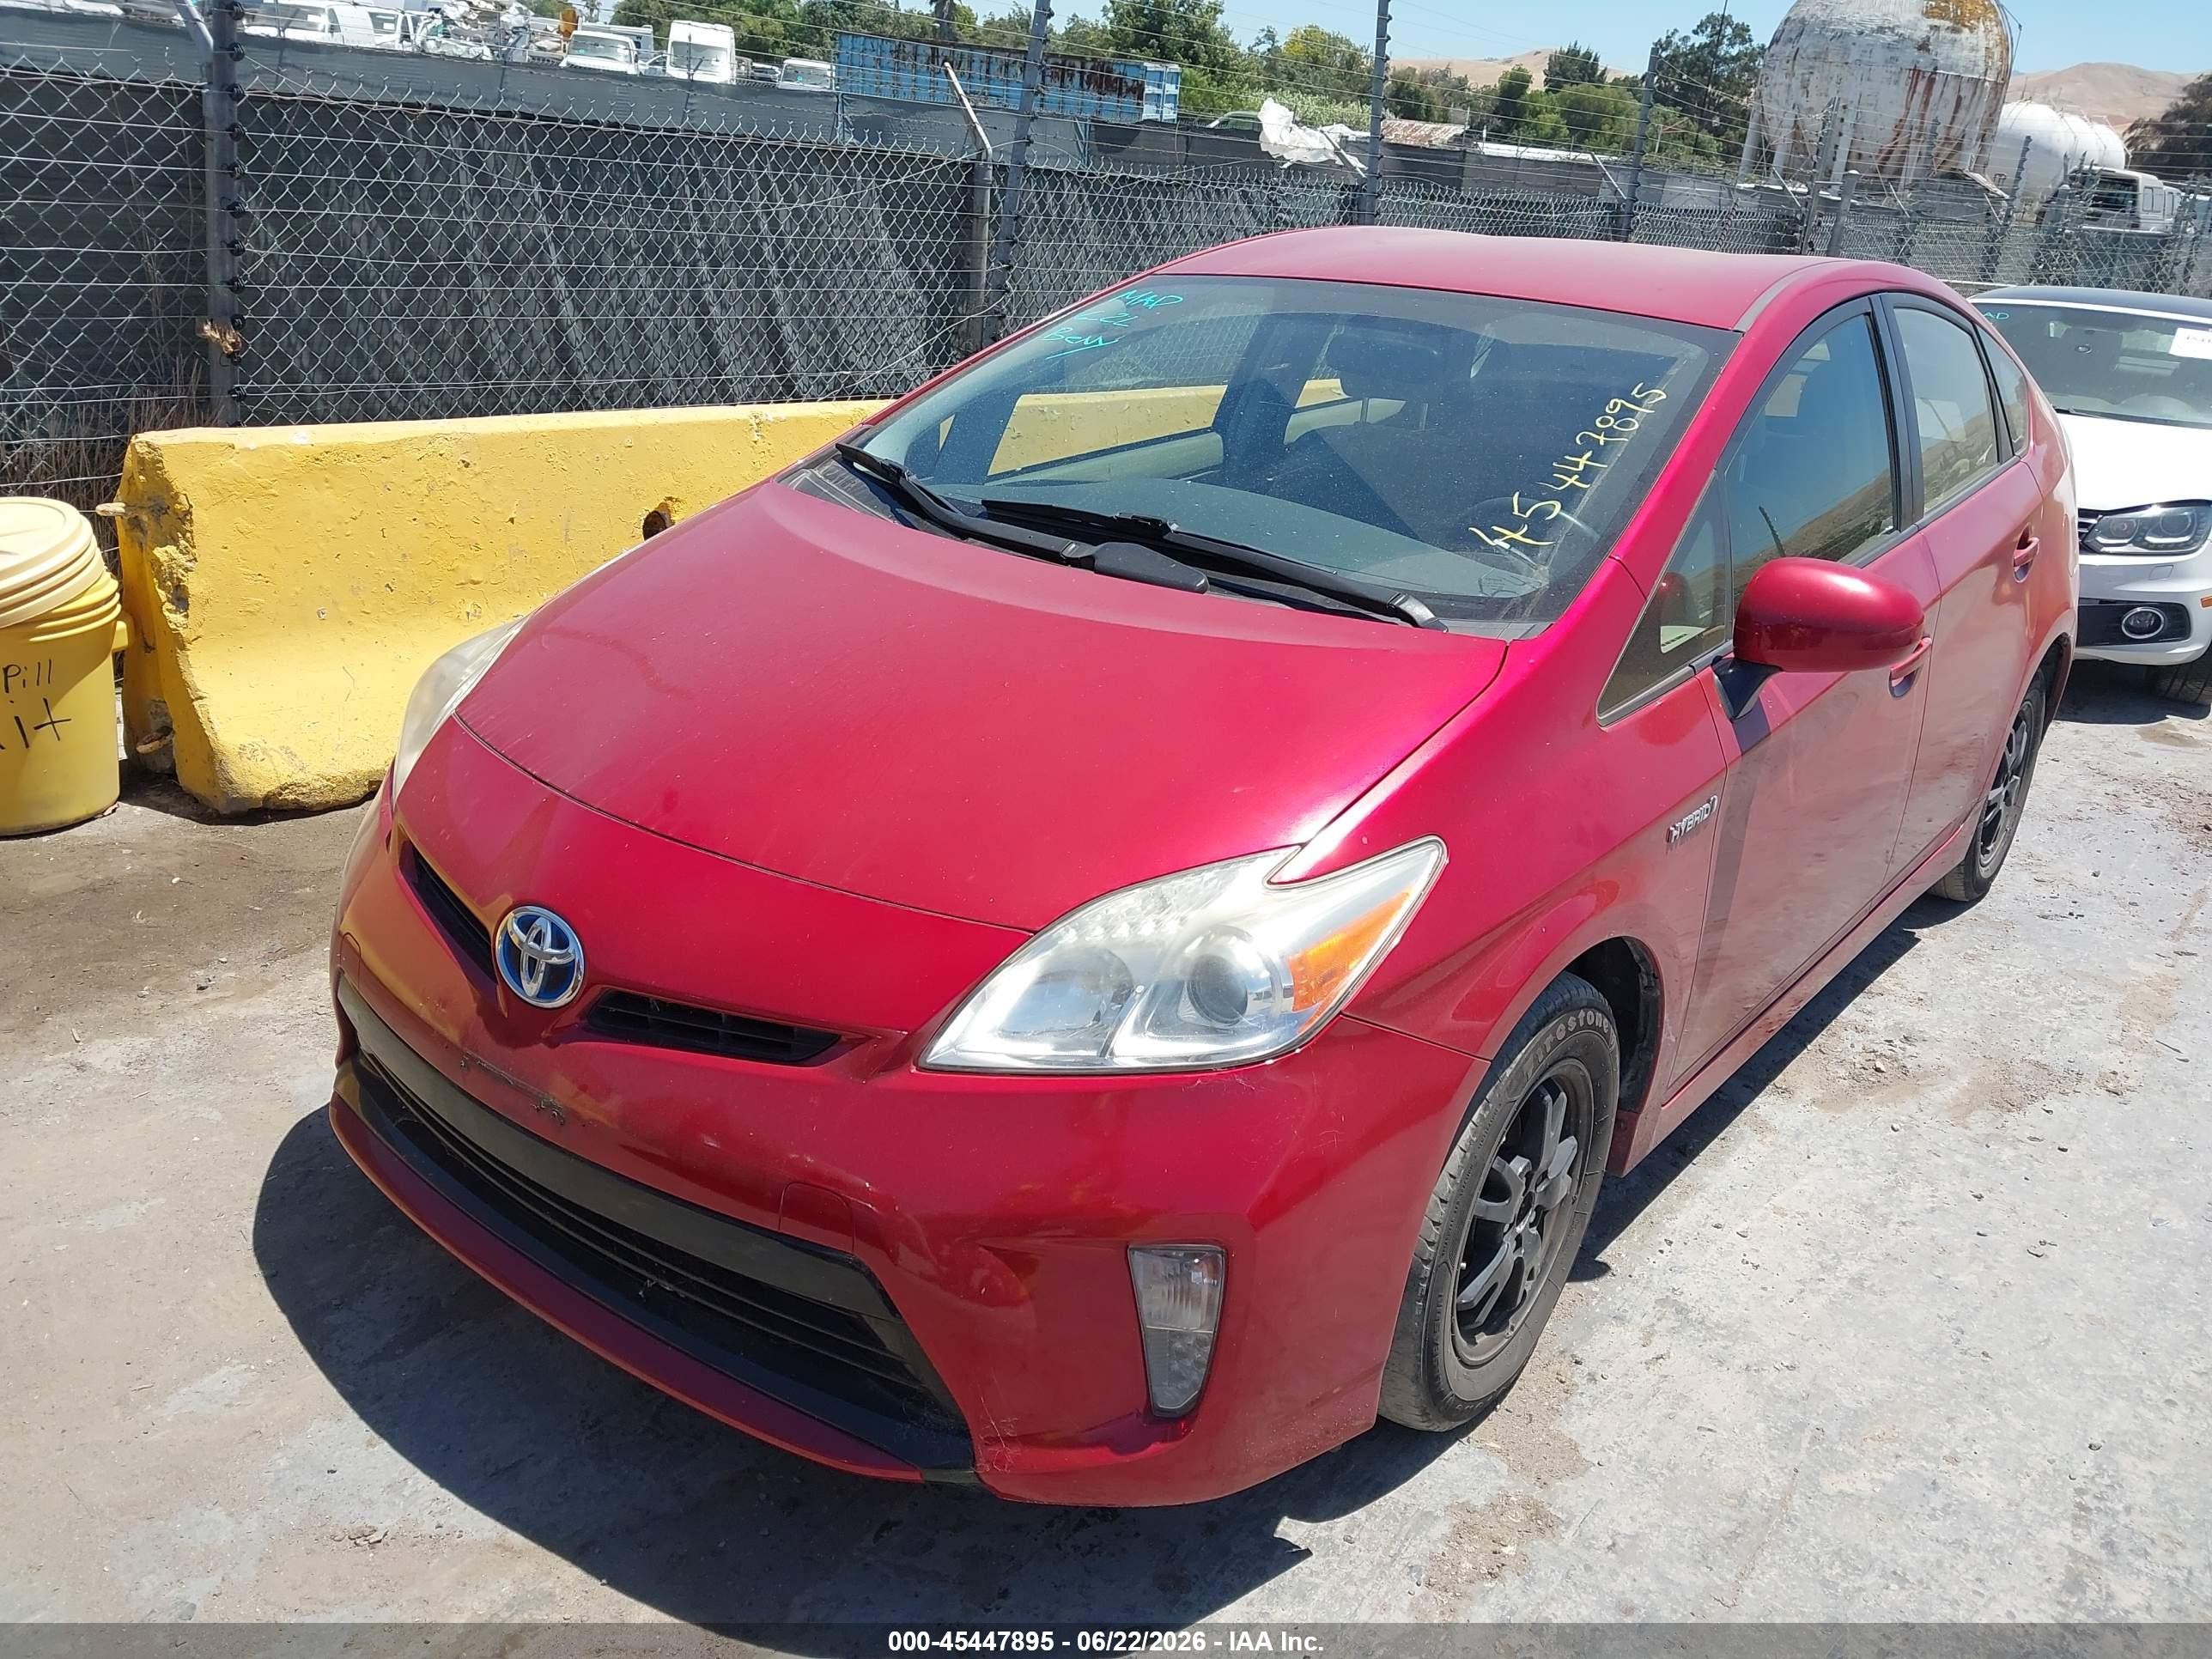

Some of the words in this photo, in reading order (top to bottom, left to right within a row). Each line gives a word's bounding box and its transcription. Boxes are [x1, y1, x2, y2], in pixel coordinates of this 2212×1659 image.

[1468, 382, 1668, 546] 45447895
[0, 697, 72, 750] it
[1666, 802, 1712, 844] HYBRID
